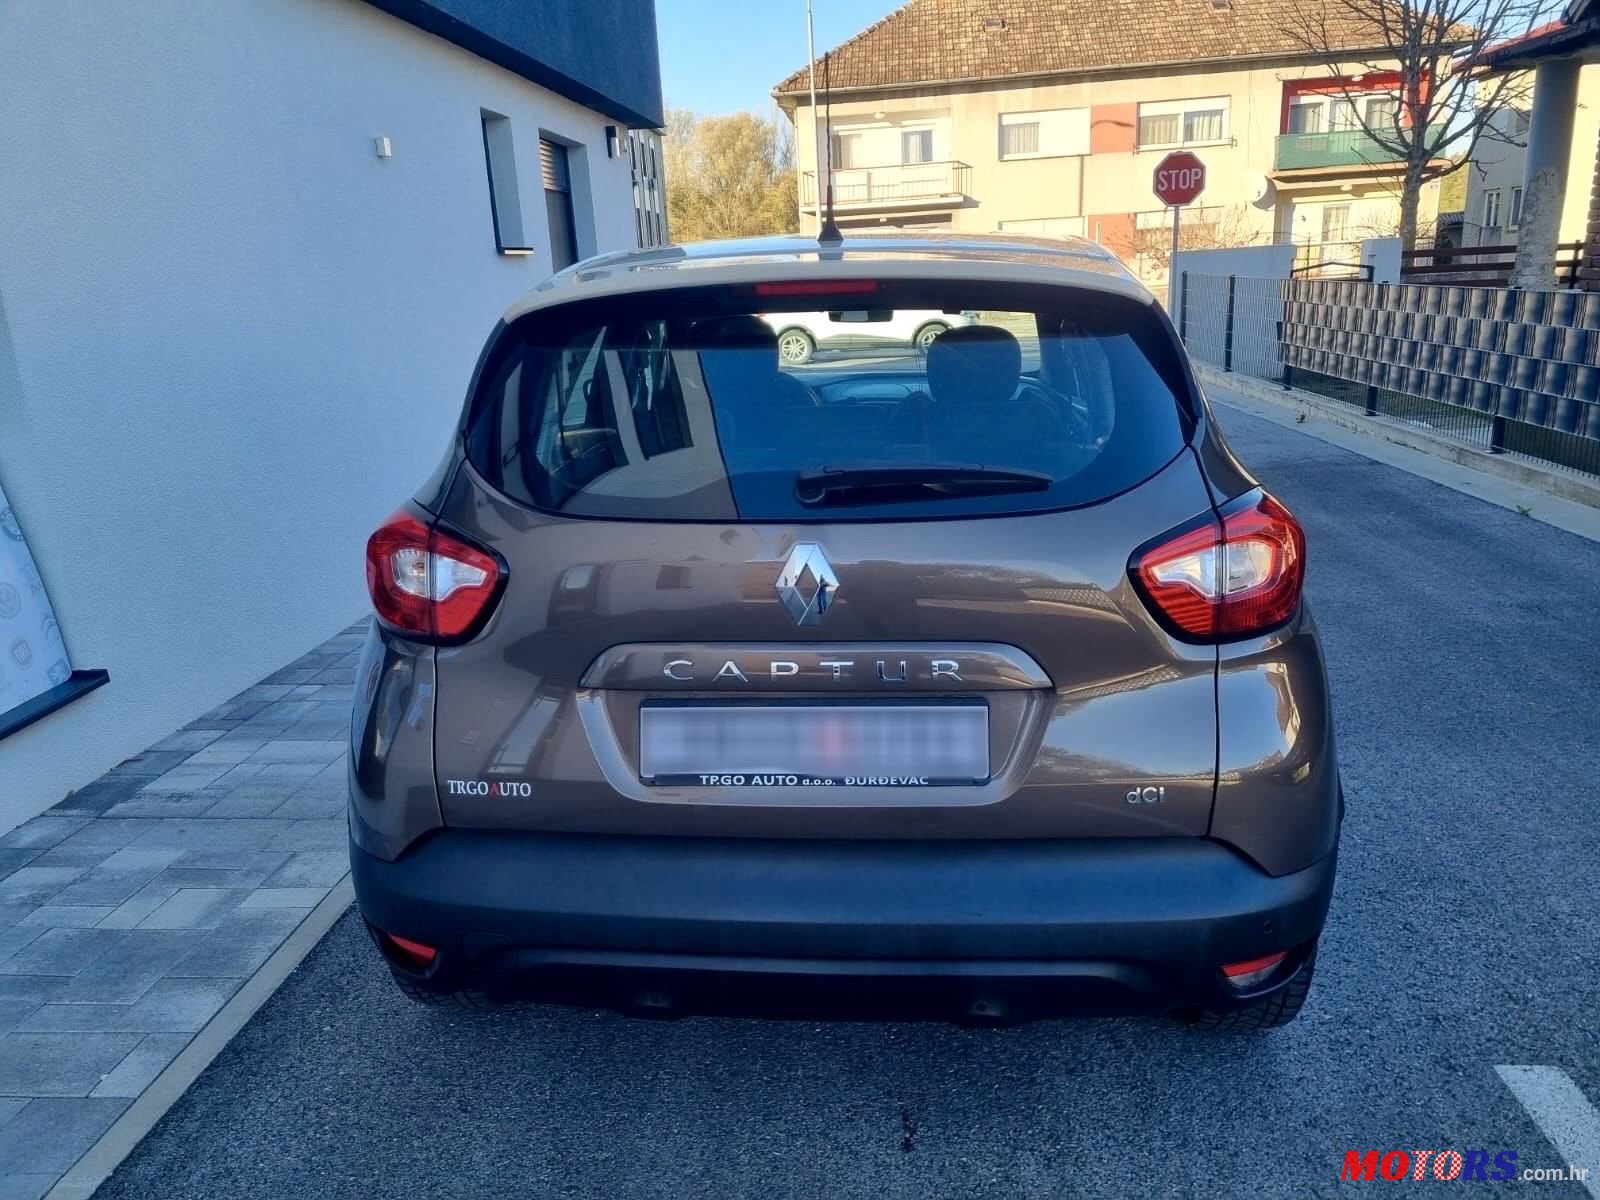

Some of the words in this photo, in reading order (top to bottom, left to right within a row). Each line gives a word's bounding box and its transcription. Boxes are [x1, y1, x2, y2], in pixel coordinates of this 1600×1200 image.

[1158, 168, 1202, 191] STOP
[663, 660, 963, 682] CAPTUR
[751, 775, 798, 786] AUTO
[801, 777, 836, 786] d.o.o.
[844, 775, 929, 786] ĐURĐEVAC
